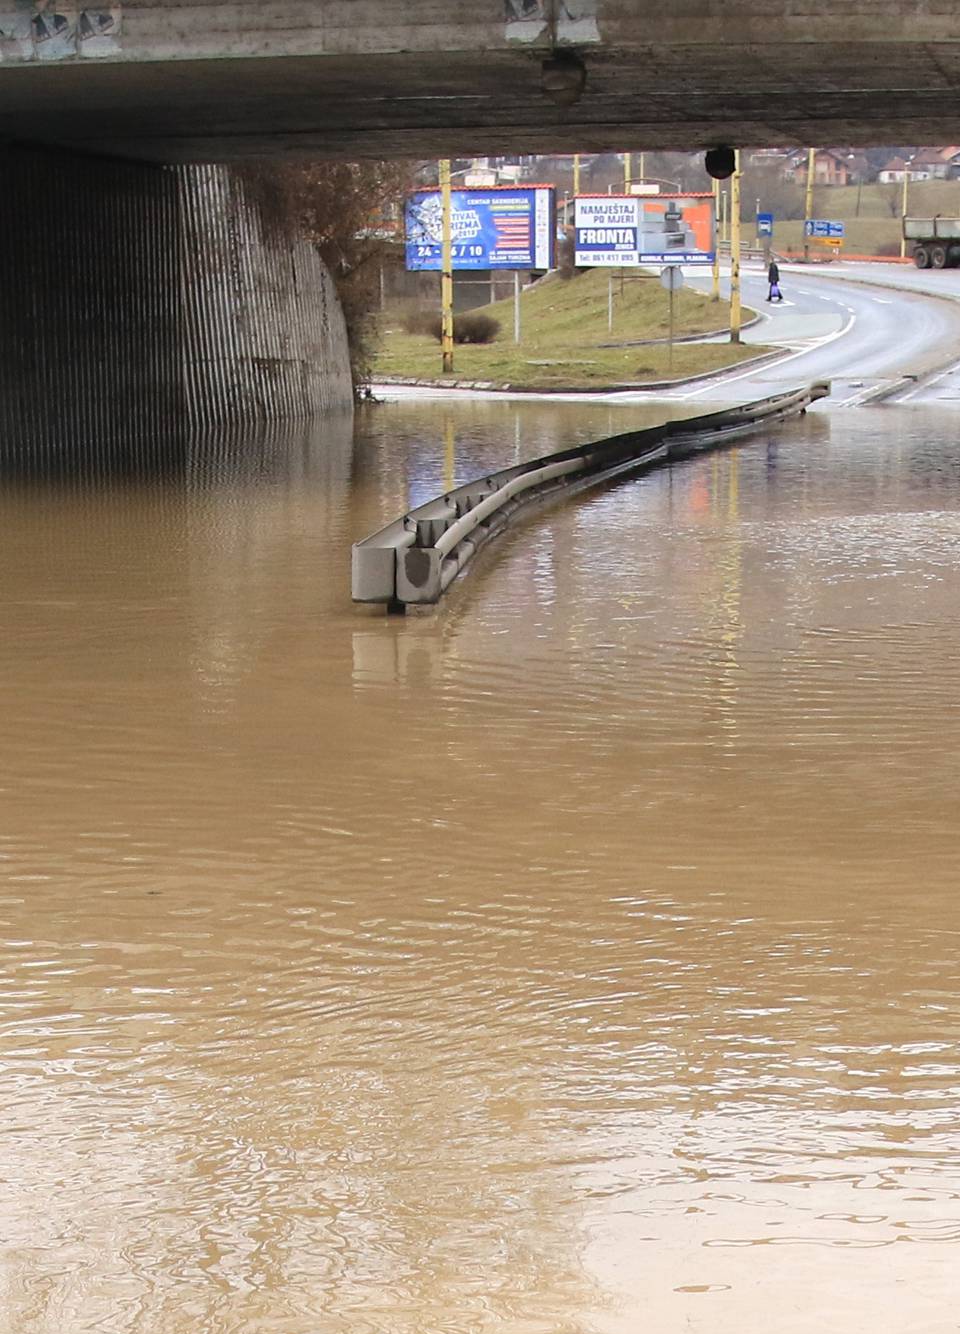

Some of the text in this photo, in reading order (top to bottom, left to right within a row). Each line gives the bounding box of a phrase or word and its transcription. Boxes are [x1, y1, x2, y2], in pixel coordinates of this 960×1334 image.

[580, 203, 635, 214] NAMJEŠTAJ
[593, 215, 634, 223] PO MJERI
[436, 220, 479, 231] TRIZMA
[579, 229, 635, 244] FRONTA
[417, 246, 432, 257] 24
[469, 246, 483, 256] 10
